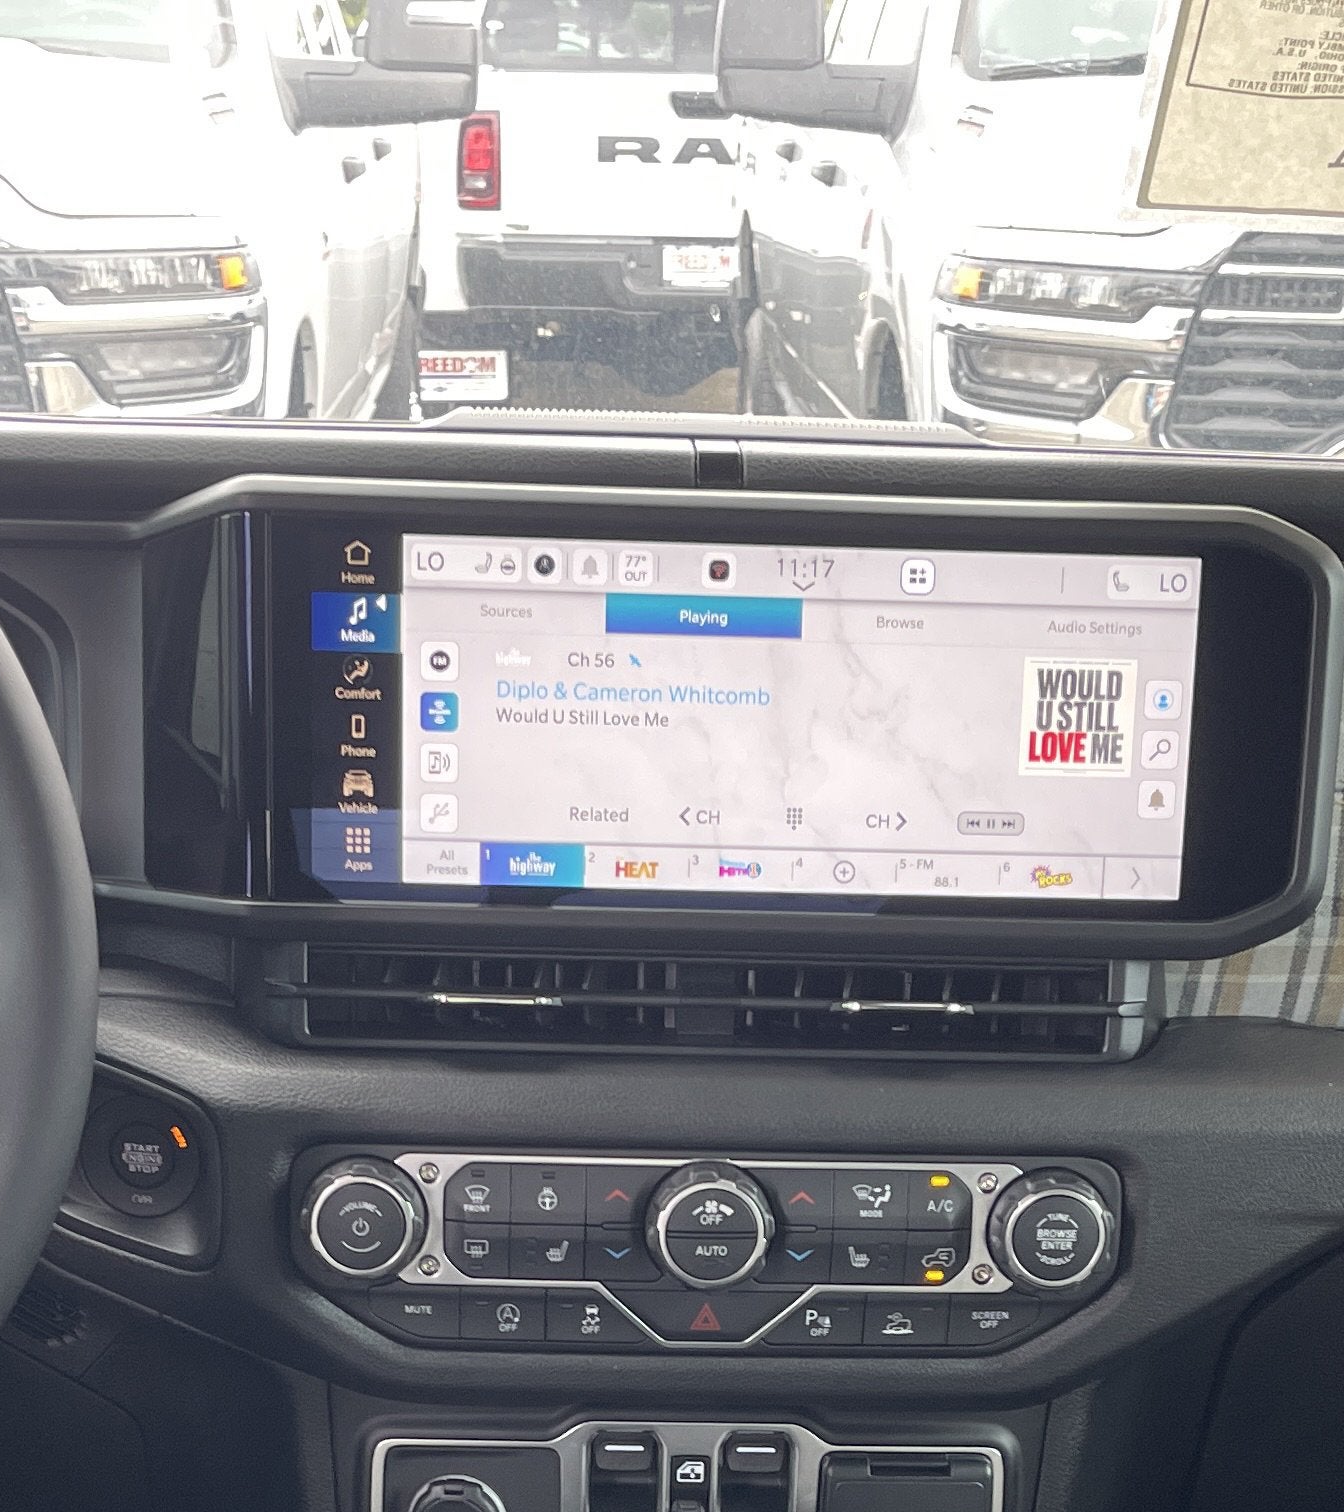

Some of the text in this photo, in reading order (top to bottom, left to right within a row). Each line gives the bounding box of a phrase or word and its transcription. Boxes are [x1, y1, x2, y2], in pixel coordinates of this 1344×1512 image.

[598, 136, 733, 164] RA
[419, 356, 496, 373] REEDOM
[417, 552, 445, 572] LO
[625, 555, 647, 568] 77°
[777, 558, 837, 580] 11:17
[341, 571, 375, 586] Home
[624, 570, 648, 582] OUT
[1159, 573, 1189, 594] LO
[479, 604, 533, 619] Sources
[679, 609, 728, 628] Playing
[876, 615, 925, 632] Browse
[1047, 619, 1144, 638] Audio Settings
[340, 628, 375, 643] Media
[567, 652, 615, 669] Ch 56
[1037, 668, 1124, 702] WOULD
[334, 686, 382, 701] Comfort
[496, 680, 771, 707] Diplo & Cameron Whitcomb
[496, 708, 669, 728] Would U Still Love Me
[1036, 701, 1119, 732] U STILL
[340, 744, 377, 759] Phone
[1028, 731, 1124, 764] LOVE ME
[338, 802, 378, 816] Vehicle
[569, 806, 629, 823] Related
[696, 809, 721, 826] CH
[866, 813, 891, 830] CH
[439, 849, 455, 862] All
[344, 859, 373, 873] Apps
[426, 863, 468, 876] Presets
[509, 857, 556, 877] highway
[616, 860, 659, 878] HEAT
[934, 876, 959, 888] 88.1
[123, 1142, 159, 1153] START
[128, 1164, 160, 1174] STOP
[463, 1203, 491, 1213] FRONT
[859, 1208, 884, 1219] MODE
[927, 1199, 954, 1214] A/C
[699, 1213, 724, 1227] OFF
[1036, 1228, 1078, 1240] BROWSE
[695, 1244, 728, 1258] AUTO
[1040, 1240, 1074, 1252] ENTER
[404, 1304, 433, 1316] MUTE
[970, 1310, 1010, 1321] SCREEN
[498, 1323, 519, 1333] OFF
[581, 1325, 601, 1335] OFF
[979, 1318, 1000, 1330] OFF
[810, 1327, 830, 1338] OFF
